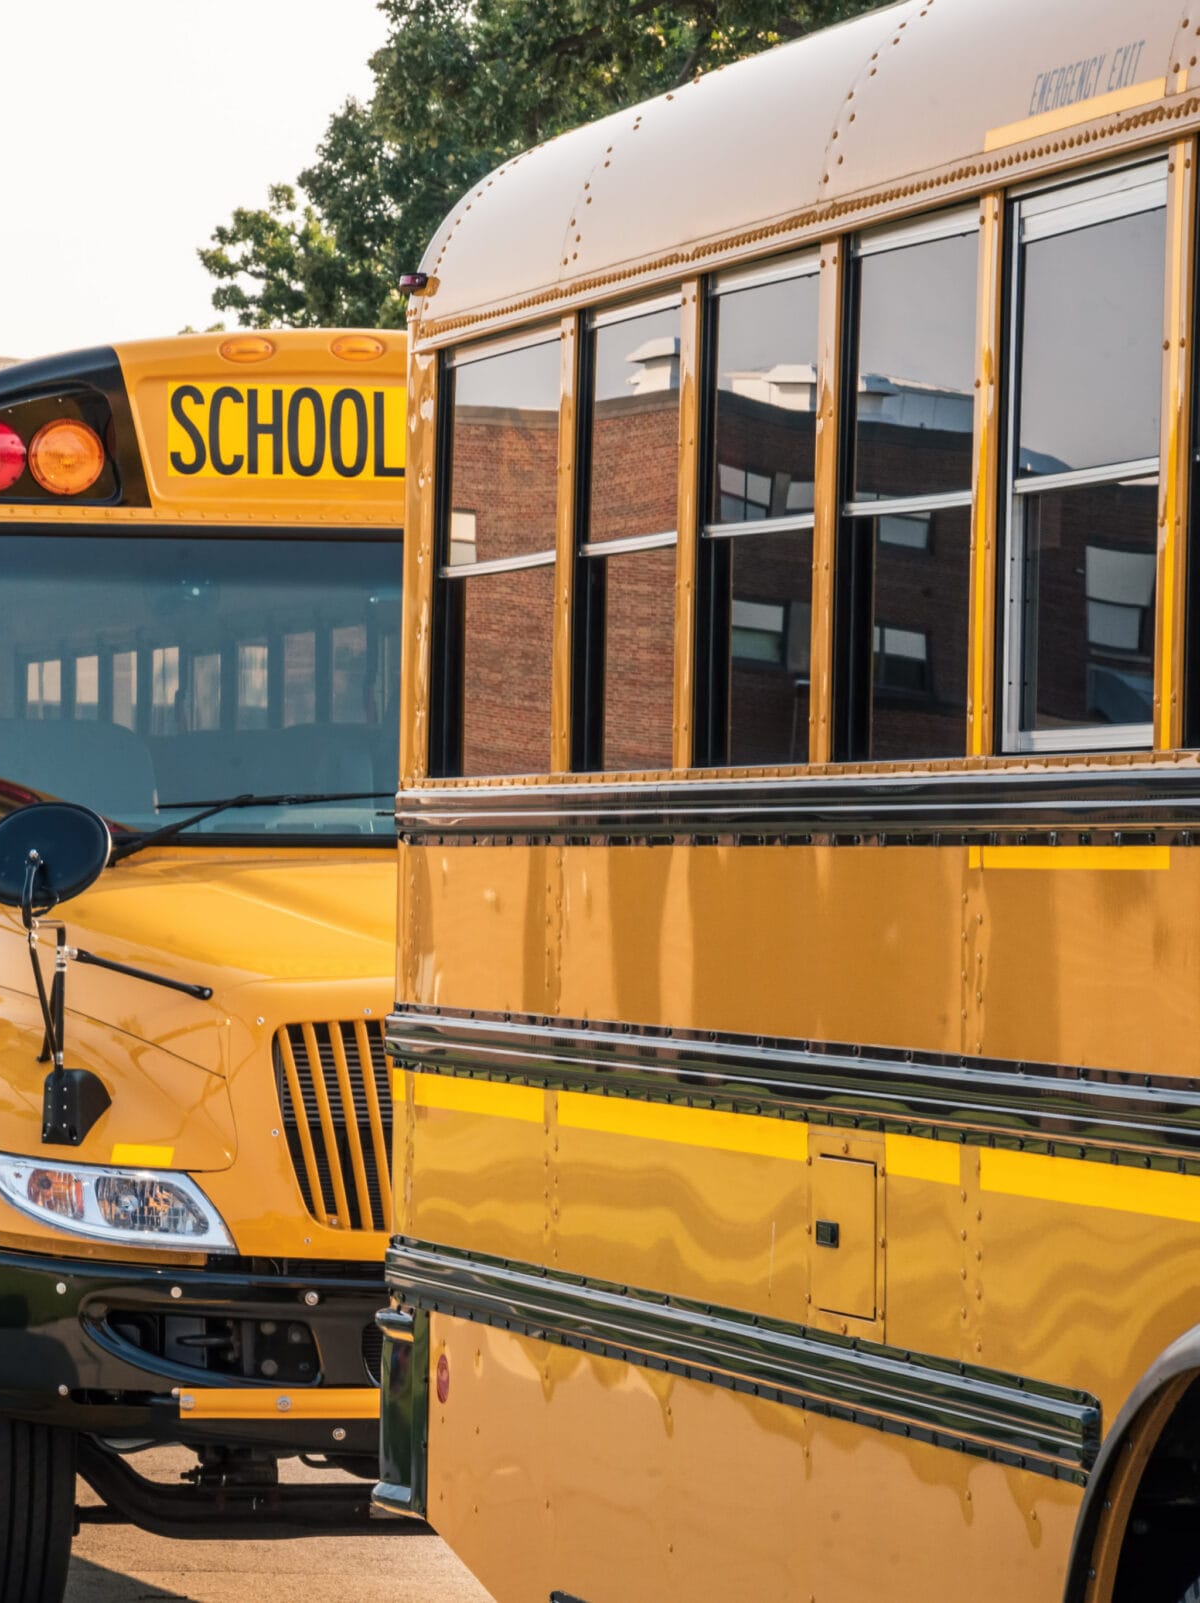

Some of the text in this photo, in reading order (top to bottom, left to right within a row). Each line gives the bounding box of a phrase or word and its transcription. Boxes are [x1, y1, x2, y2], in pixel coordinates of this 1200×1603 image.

[1028, 40, 1146, 116] EMERGENCY EXIT
[170, 384, 405, 477] SCHOOL
